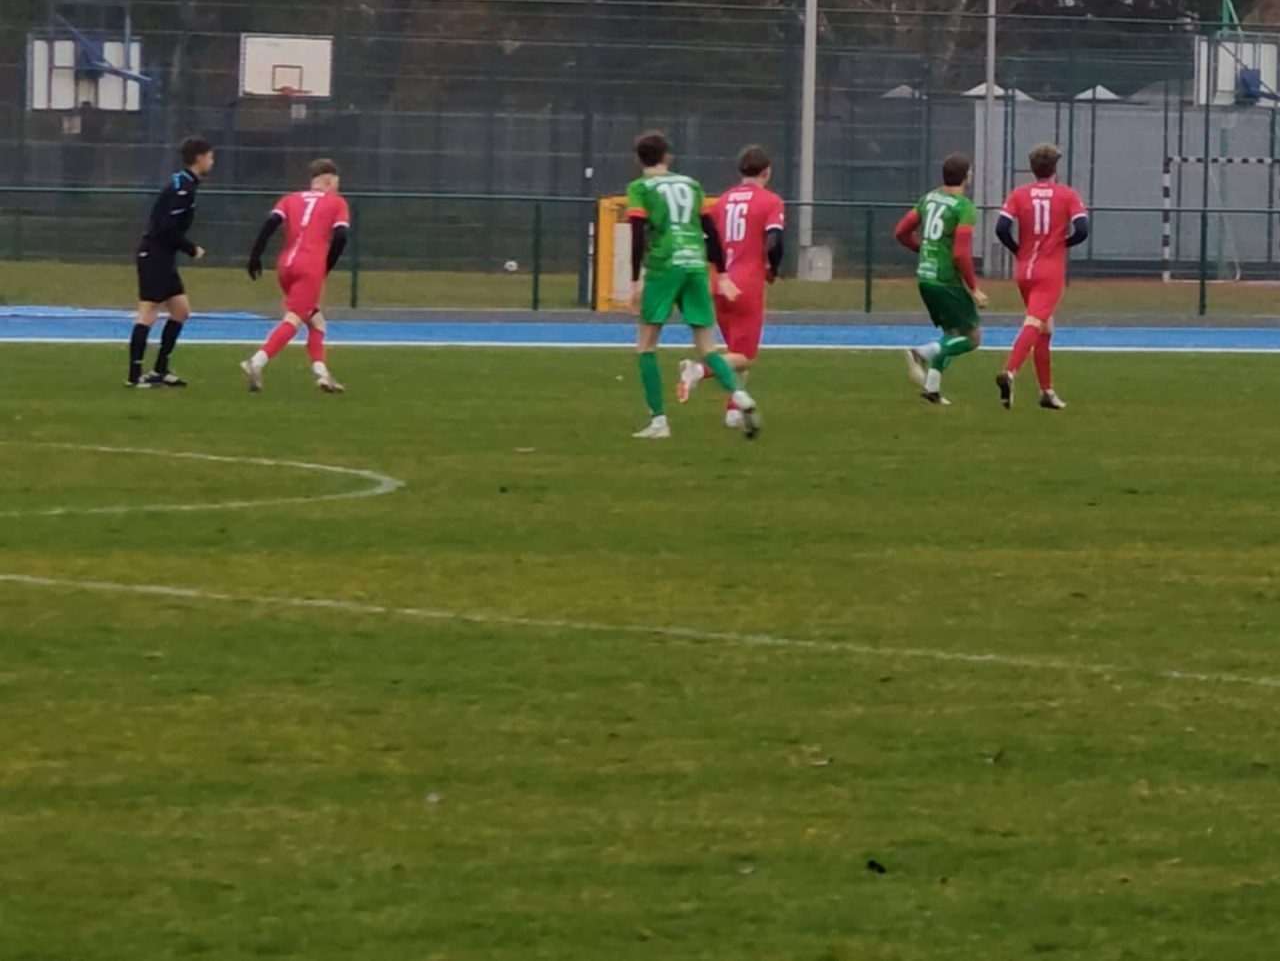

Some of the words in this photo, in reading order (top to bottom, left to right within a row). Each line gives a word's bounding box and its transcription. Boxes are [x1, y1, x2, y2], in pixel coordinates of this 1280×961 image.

[302, 198, 318, 227] 7
[656, 183, 694, 223] 19
[923, 202, 945, 240] 16
[1032, 199, 1051, 235] 11
[725, 203, 749, 242] 16
